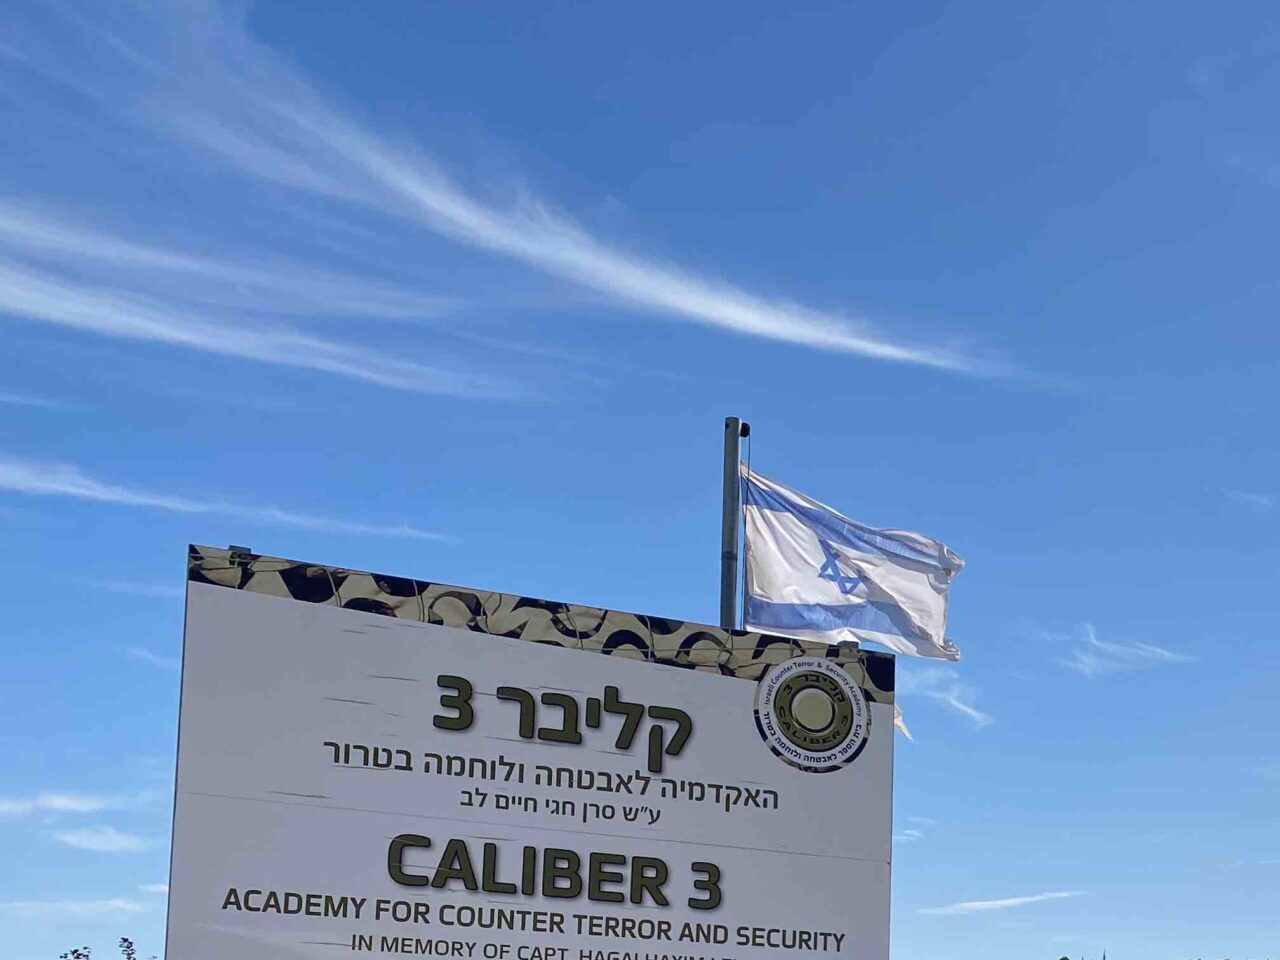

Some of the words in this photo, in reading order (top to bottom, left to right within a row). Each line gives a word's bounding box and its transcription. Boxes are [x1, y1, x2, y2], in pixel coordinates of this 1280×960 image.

[432, 674, 474, 731] 3
[764, 684, 774, 705] Israeli
[771, 665, 794, 684] Counter
[793, 661, 814, 669] Terror
[825, 664, 850, 686] Security
[848, 685, 862, 717] Academy
[496, 685, 692, 773] קליבר
[763, 711, 777, 736] בטרור
[779, 706, 841, 744] CALIBER
[323, 741, 413, 771] בטרור
[775, 736, 801, 759] ולוחמה
[803, 753, 837, 763] לאבטחה
[424, 752, 524, 783] ולוחמה
[535, 765, 651, 796] לאבטחה
[460, 787, 488, 807] לב
[495, 793, 537, 813] חיים
[545, 798, 575, 817] חגי
[661, 778, 779, 812] האקדמיה
[582, 802, 615, 823] סרן
[388, 834, 670, 906] CALIBER
[688, 862, 721, 910] 3
[221, 888, 367, 919] ACADEMY
[375, 899, 430, 924] FOR
[439, 904, 565, 934] COUNTER
[573, 914, 672, 941] TERROR
[679, 922, 729, 945] AND
[736, 926, 845, 952] SECURITY
[351, 934, 373, 951] IN
[380, 936, 477, 958] MEMORY
[483, 943, 511, 960] OF
